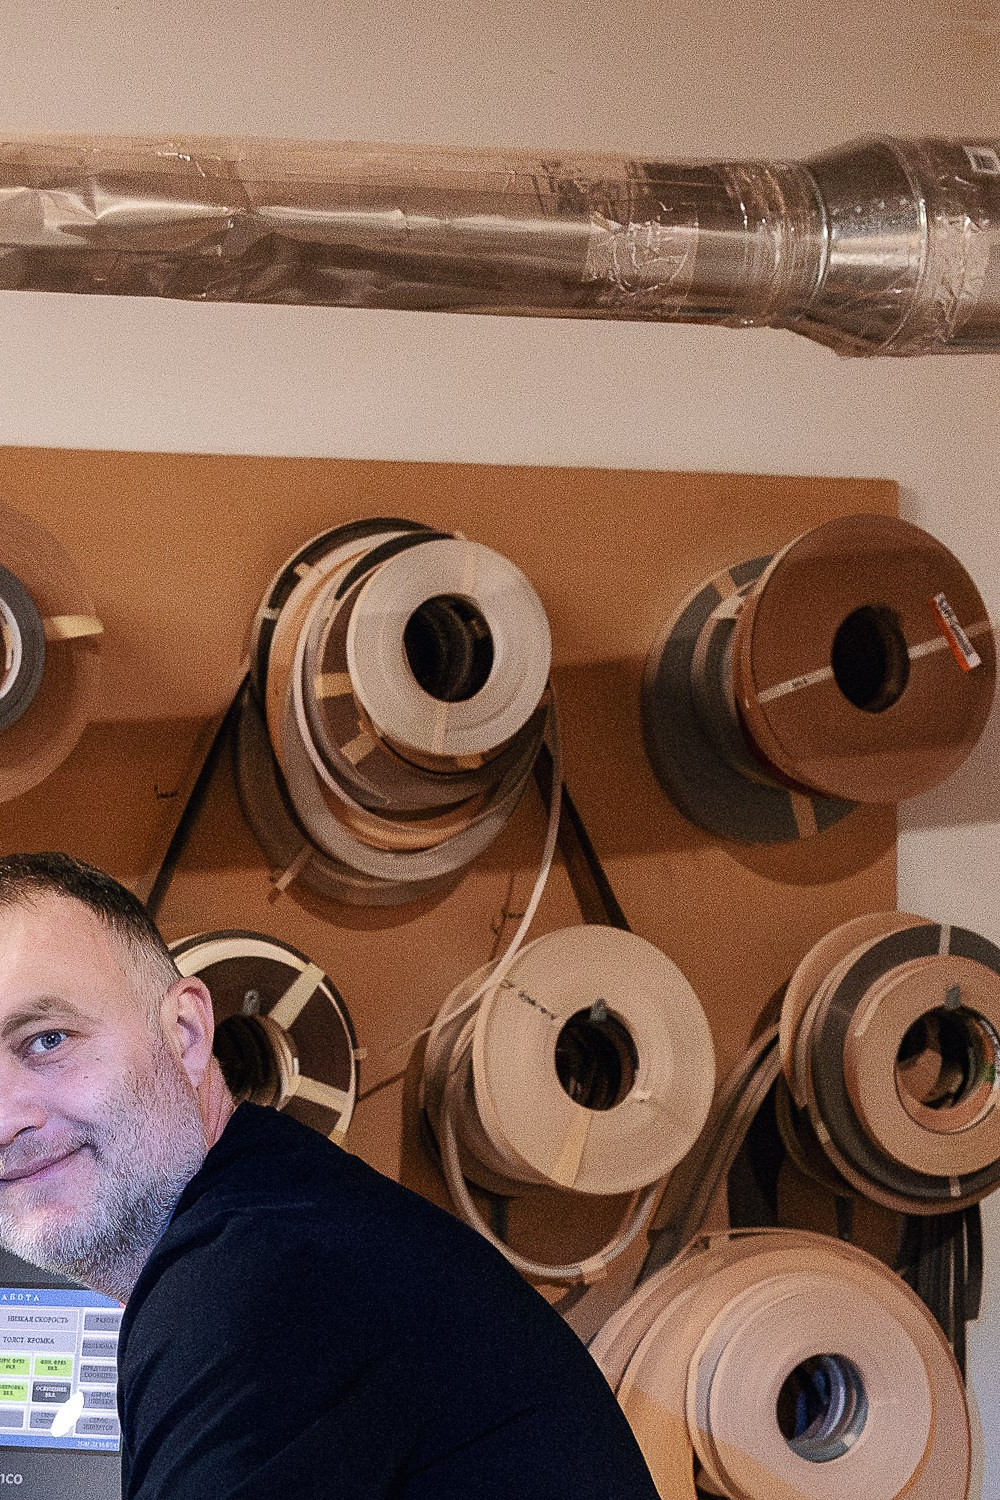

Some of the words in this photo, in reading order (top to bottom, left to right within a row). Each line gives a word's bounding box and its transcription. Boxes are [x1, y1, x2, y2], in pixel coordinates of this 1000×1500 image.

[7, 1315, 34, 1323] НИЗКАЯ
[35, 1316, 69, 1324] СКОРОСТЬ
[27, 1337, 55, 1345] КРОМКА
